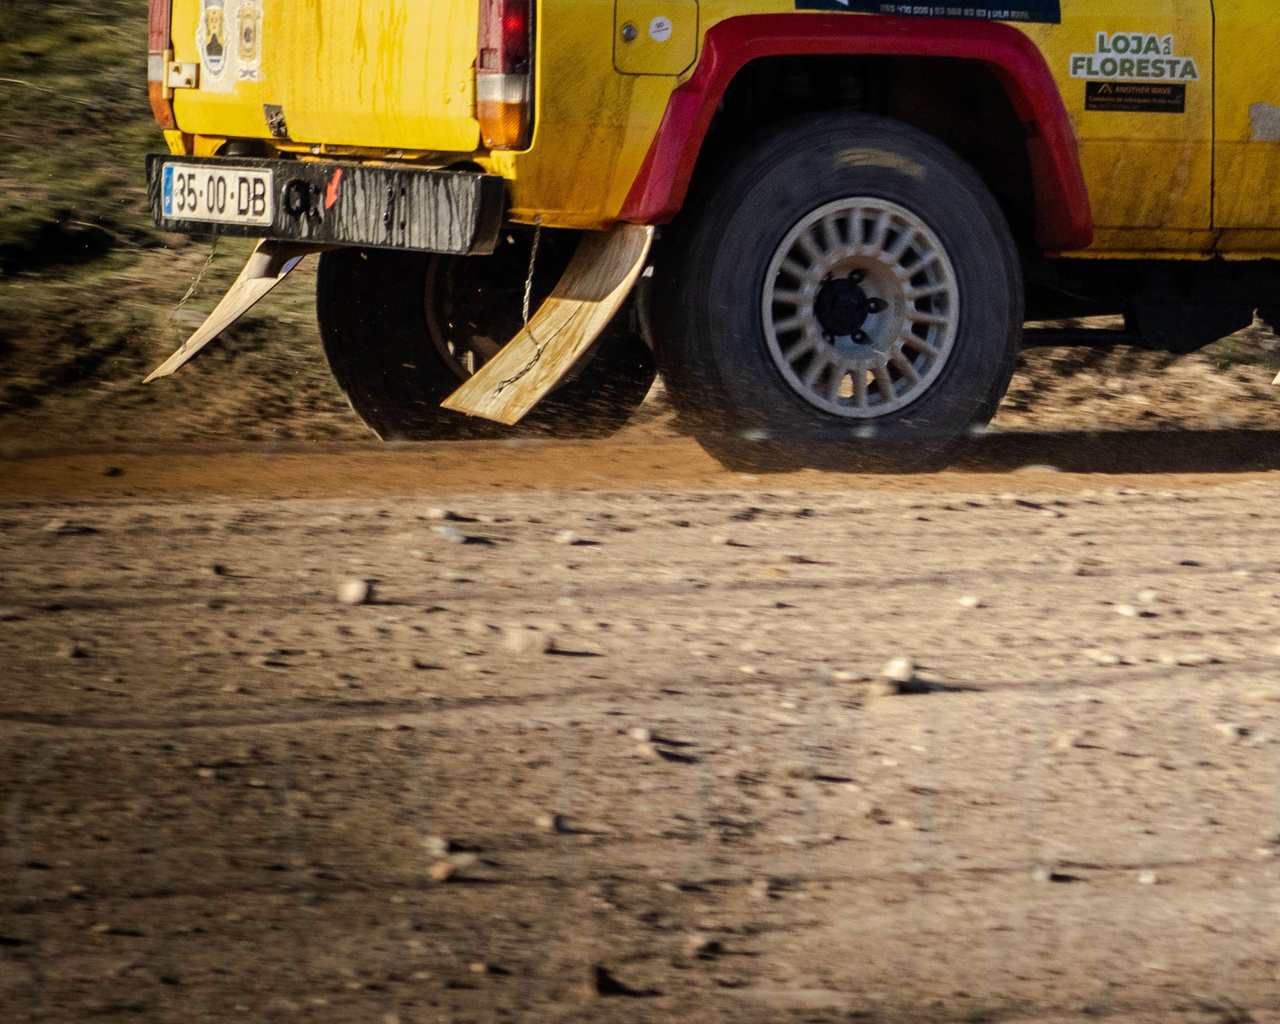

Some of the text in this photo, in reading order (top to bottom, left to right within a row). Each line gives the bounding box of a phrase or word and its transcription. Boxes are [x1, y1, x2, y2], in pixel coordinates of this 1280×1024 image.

[1098, 34, 1171, 55] LOJA DA
[1071, 57, 1198, 78] FLORESTA
[1151, 87, 1172, 95] WAVE
